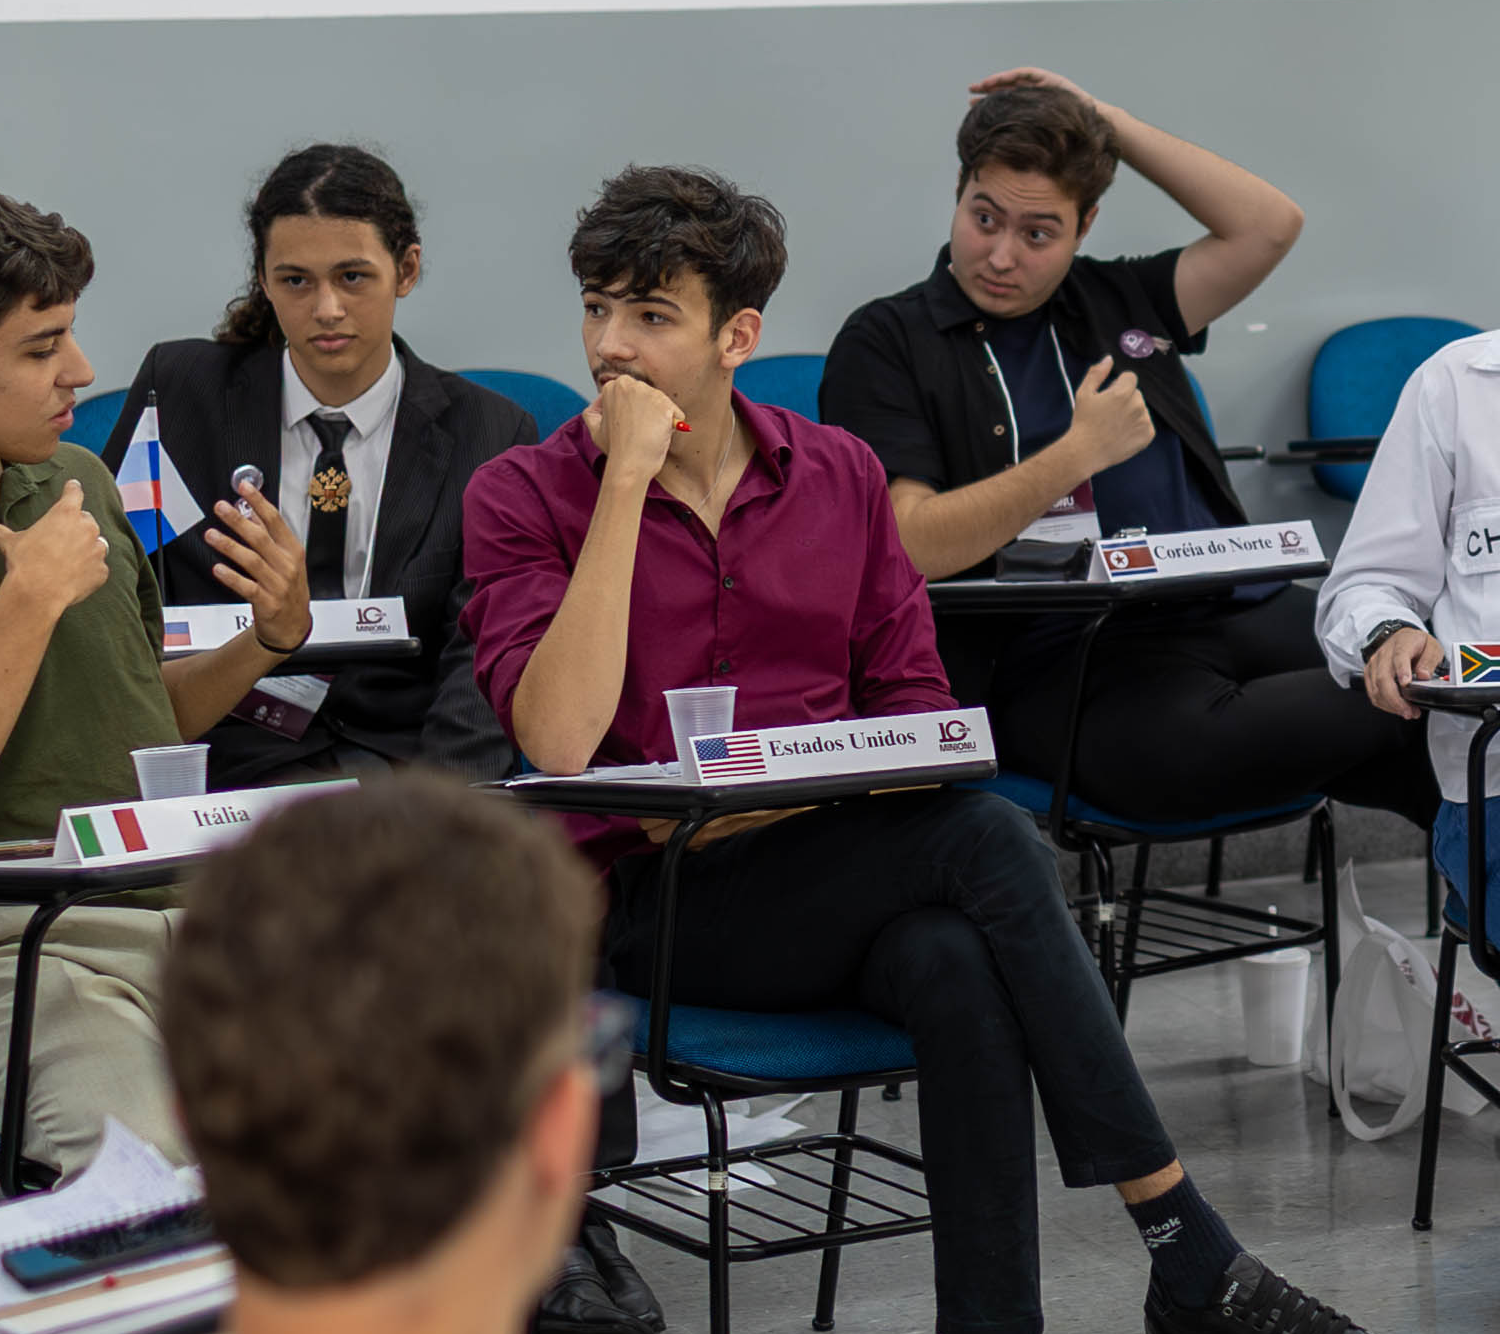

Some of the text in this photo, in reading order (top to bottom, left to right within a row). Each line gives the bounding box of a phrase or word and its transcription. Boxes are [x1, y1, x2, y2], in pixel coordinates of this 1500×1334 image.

[1154, 537, 1273, 560] Coréia do Norte
[769, 729, 917, 757] Estados Unidos
[191, 806, 252, 827] Itália
